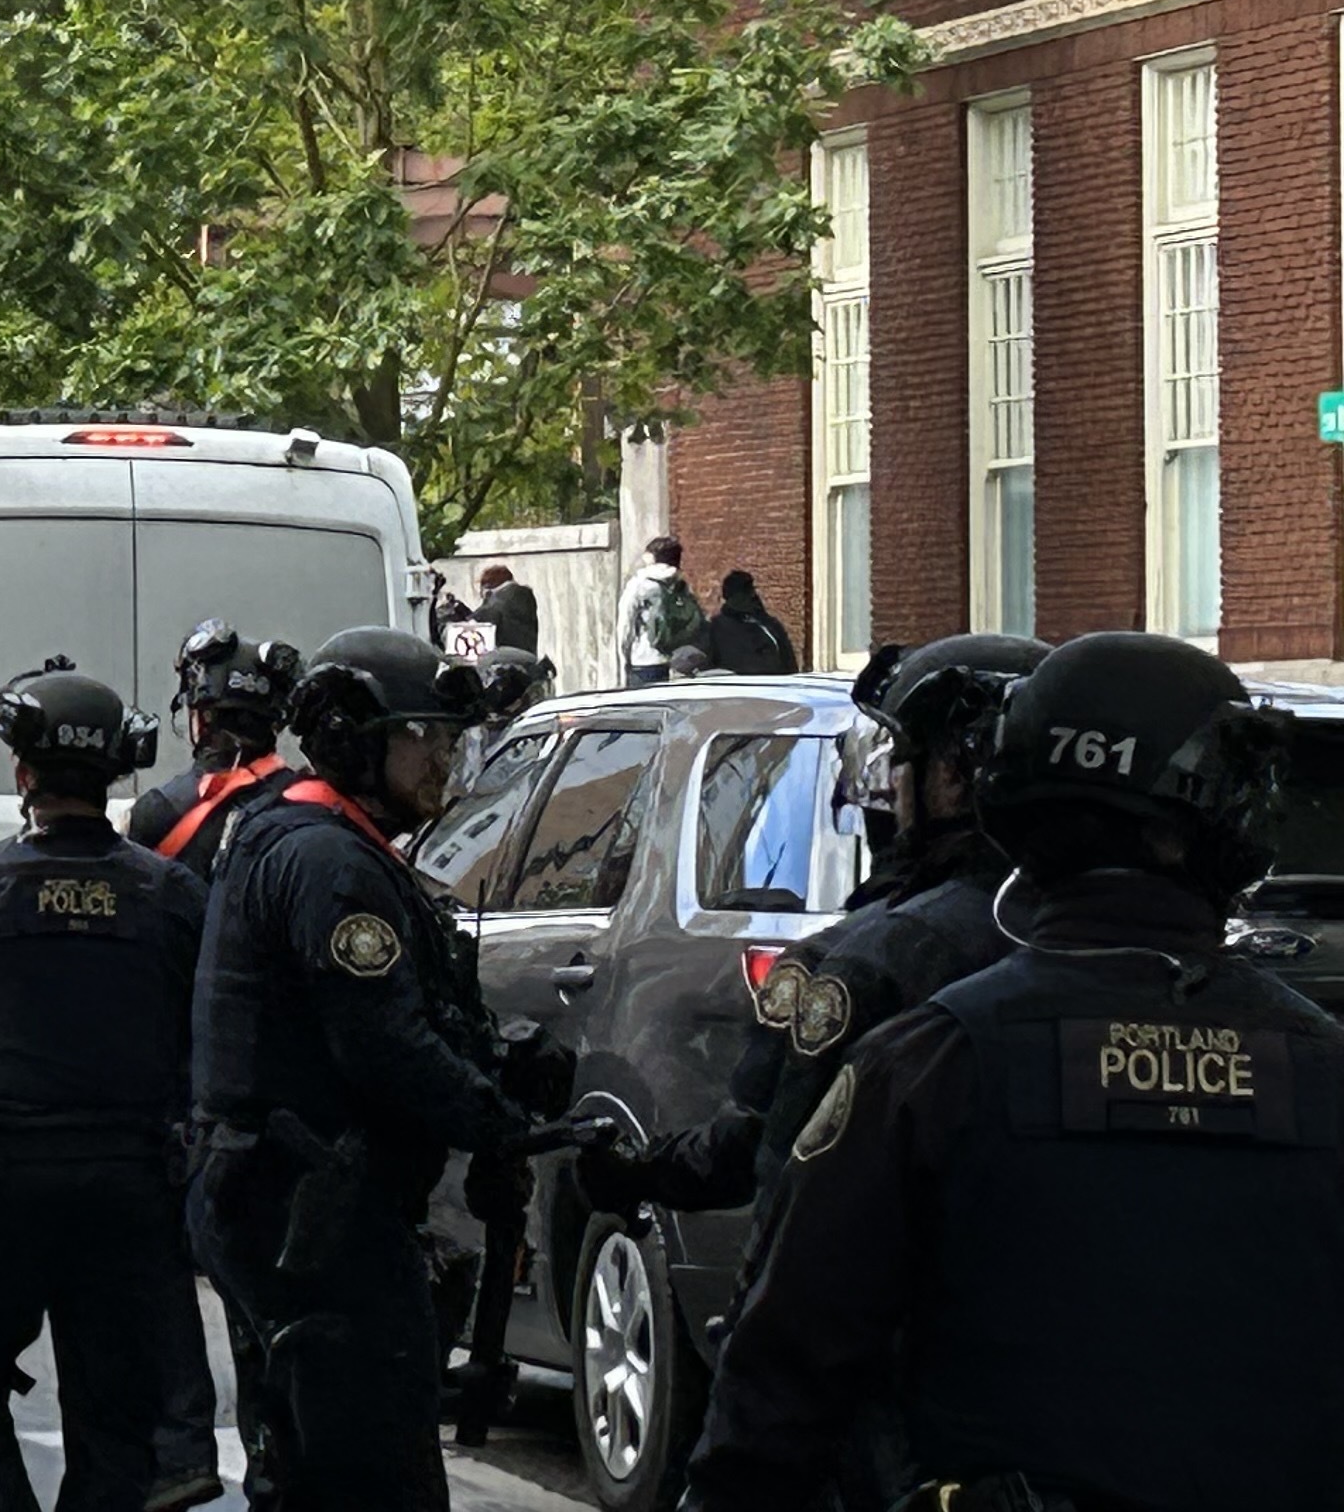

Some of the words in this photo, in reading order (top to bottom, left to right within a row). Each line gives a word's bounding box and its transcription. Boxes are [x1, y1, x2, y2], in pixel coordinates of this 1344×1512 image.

[1049, 726, 1137, 776] 761
[37, 889, 117, 917] POLICE
[1109, 1022, 1240, 1054] PORTLAND
[1100, 1046, 1255, 1096] POLICE
